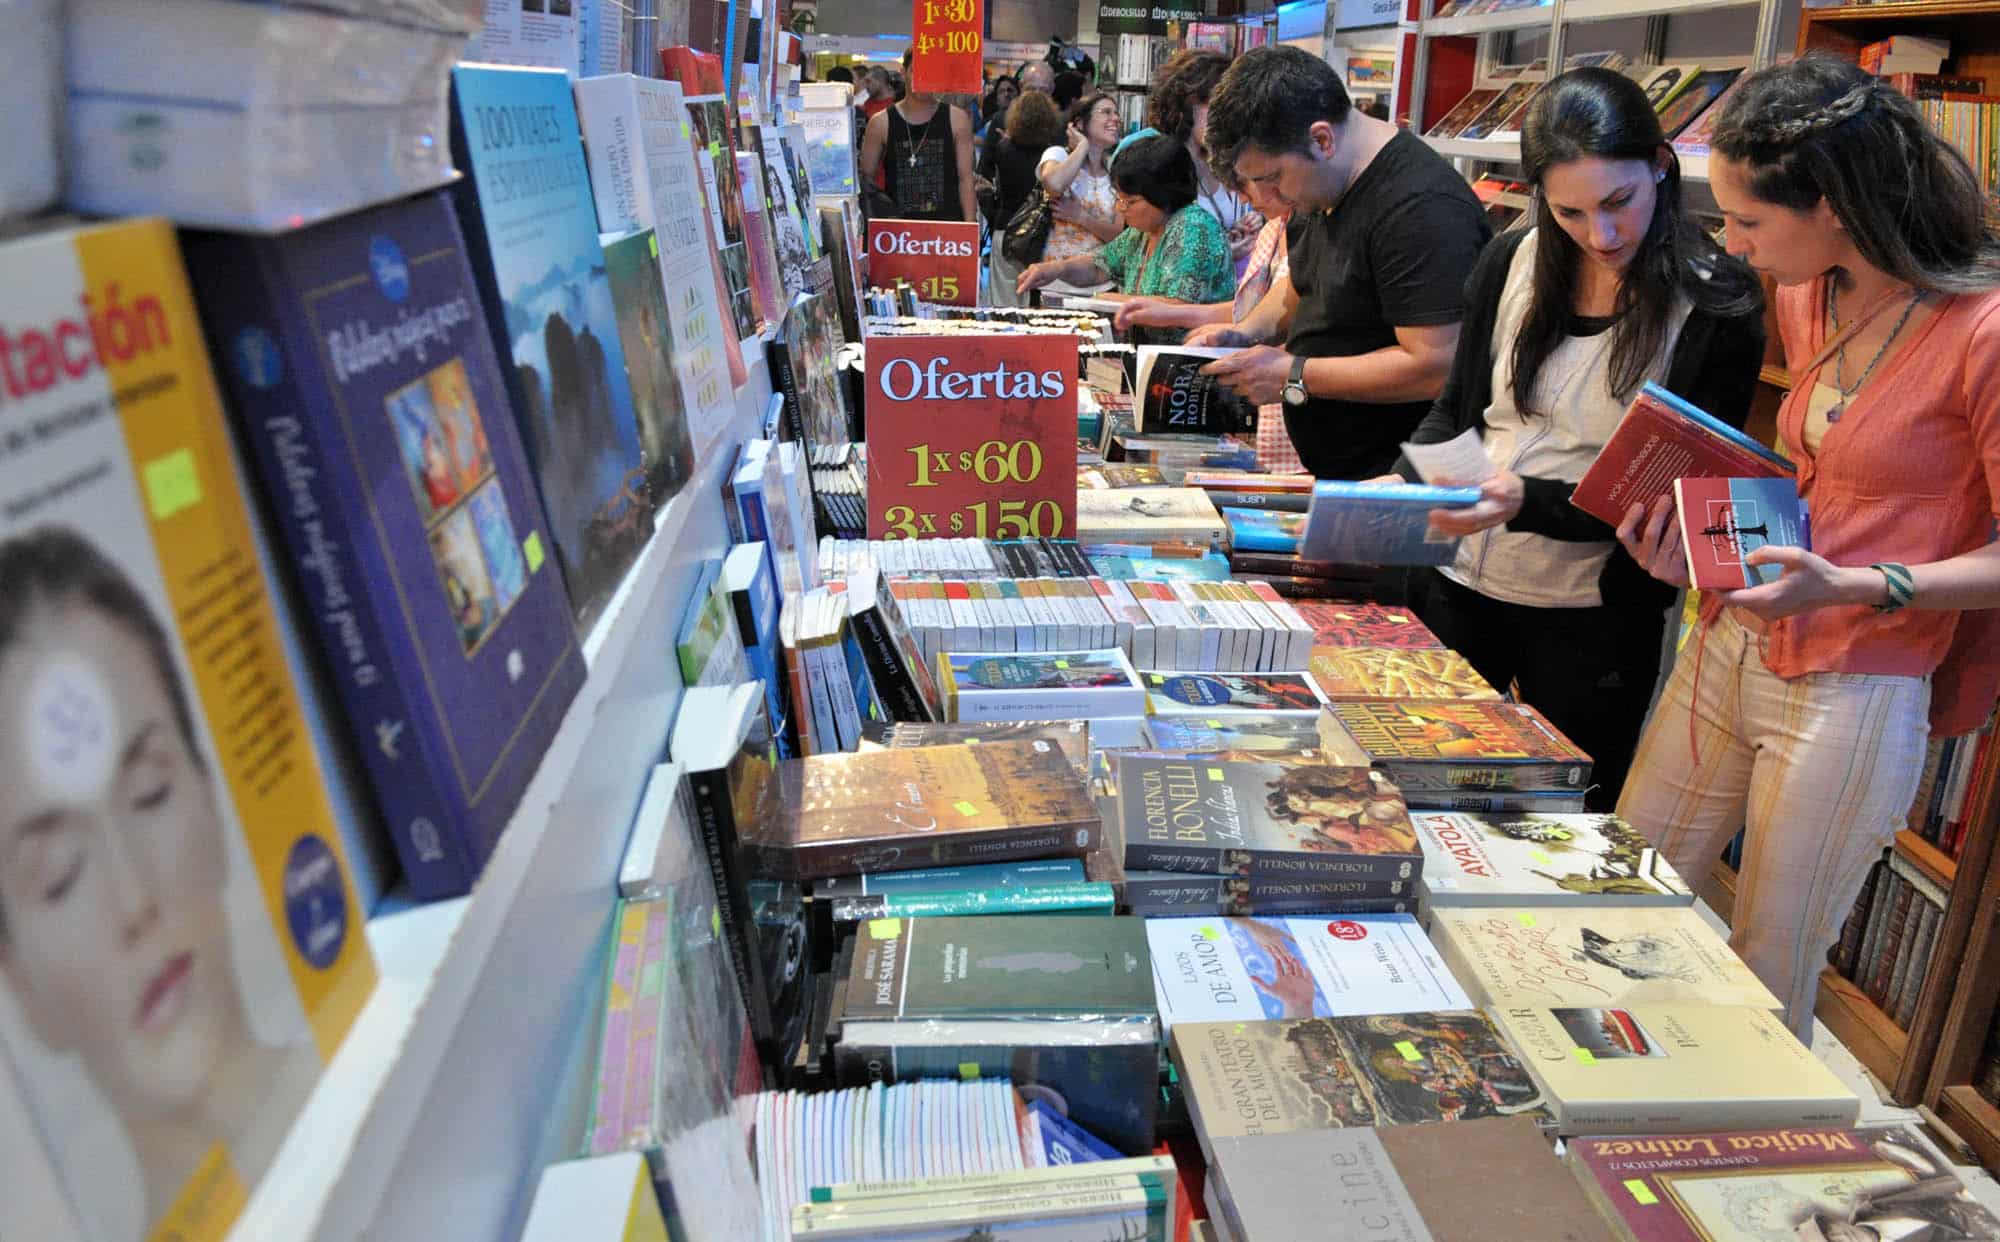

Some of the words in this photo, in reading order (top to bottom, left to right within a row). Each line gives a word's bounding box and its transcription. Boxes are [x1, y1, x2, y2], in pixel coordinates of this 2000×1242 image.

[923, 2, 940, 25] 1x
[944, 0, 975, 23] $30
[918, 32, 936, 55] 4x
[939, 31, 979, 54] $100
[874, 231, 973, 256] Ofertas
[921, 276, 960, 301] $15
[880, 357, 1064, 400] Ofertas
[1168, 362, 1199, 425] NORA
[906, 443, 952, 487] 1x
[959, 440, 1043, 484] $60
[884, 504, 937, 540] 3x
[950, 499, 1064, 540] $150
[1143, 767, 1169, 841] FLORENCIA
[1166, 765, 1207, 842] BONELLI
[1426, 815, 1491, 878] AYATOLA
[1258, 858, 1307, 873] BONELLI
[1308, 862, 1374, 874] FLORENCIA
[1255, 885, 1306, 897] BONELLI
[1307, 881, 1367, 894] FLORENCIA
[879, 939, 898, 980] SARAMA
[1175, 951, 1199, 984] LAZOS
[1191, 933, 1227, 977] AMOR
[1385, 963, 1404, 983] Brian
[875, 981, 893, 1005] JOSÉ
[1210, 982, 1237, 1004] DE
[1208, 1027, 1238, 1073] TEATRO
[1233, 1039, 1266, 1090] MUNDO
[1232, 1079, 1257, 1120] GRAN
[1258, 1095, 1281, 1121] DEL
[1247, 1123, 1263, 1136] EL
[1727, 1129, 1857, 1152] Mujica
[1593, 1137, 1723, 1158] Lainez
[1622, 1157, 1699, 1170] COMPLETOS
[1699, 1155, 1760, 1167] CUENTOS
